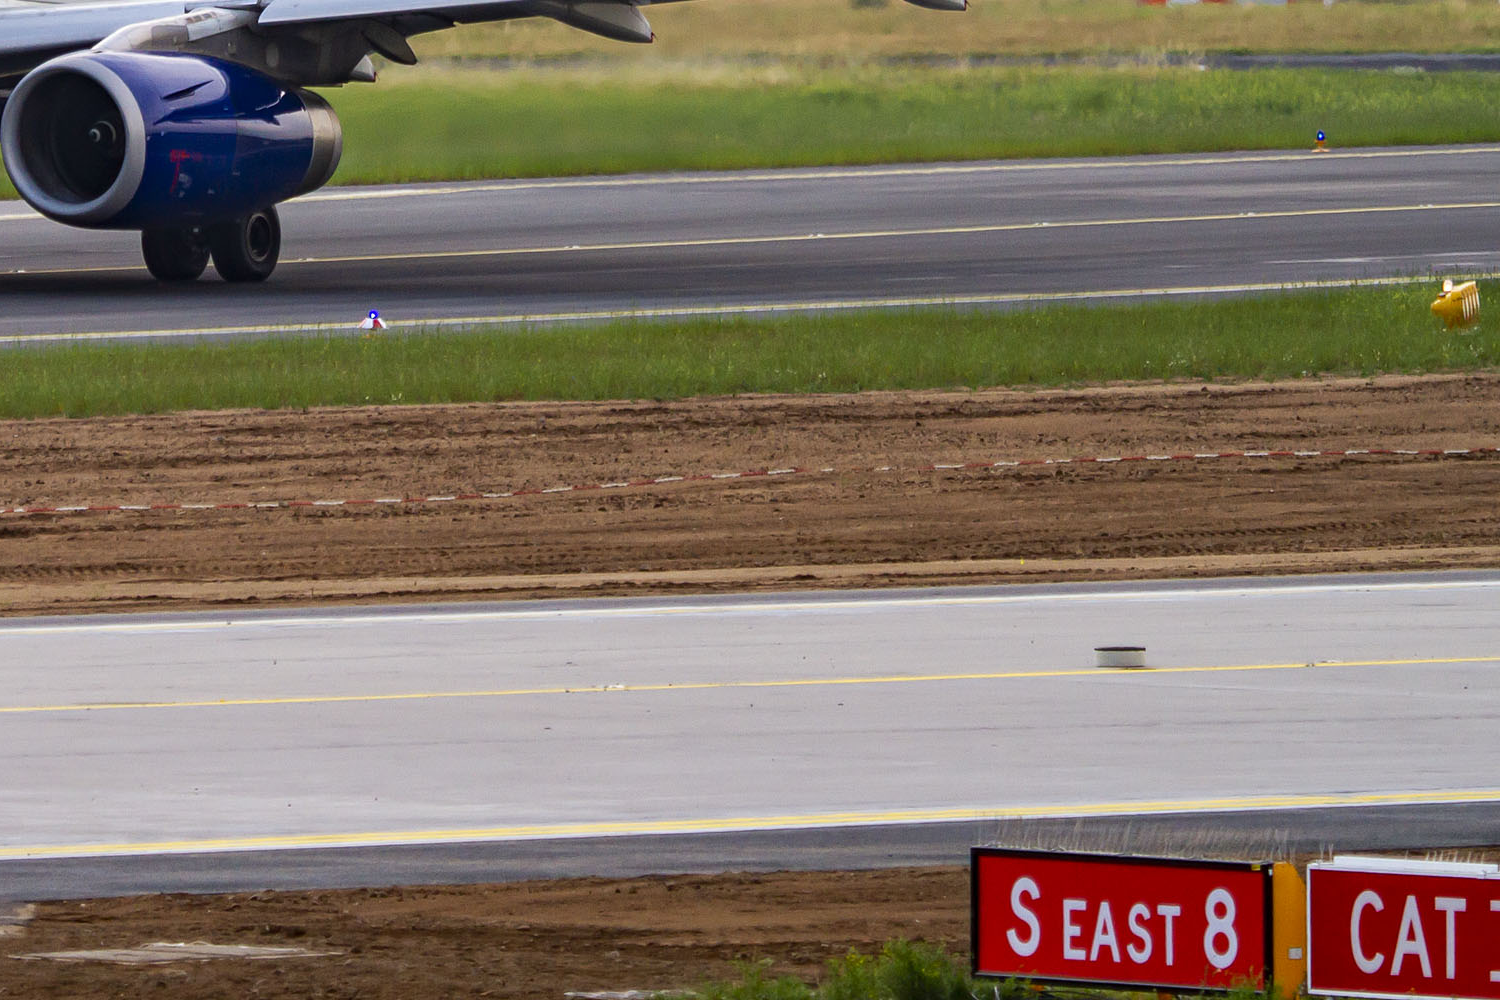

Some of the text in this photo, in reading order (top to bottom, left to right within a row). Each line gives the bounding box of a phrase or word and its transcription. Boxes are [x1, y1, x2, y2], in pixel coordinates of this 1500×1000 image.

[1006, 877, 1238, 970] S EAST 8
[1349, 890, 1467, 980] CAT
